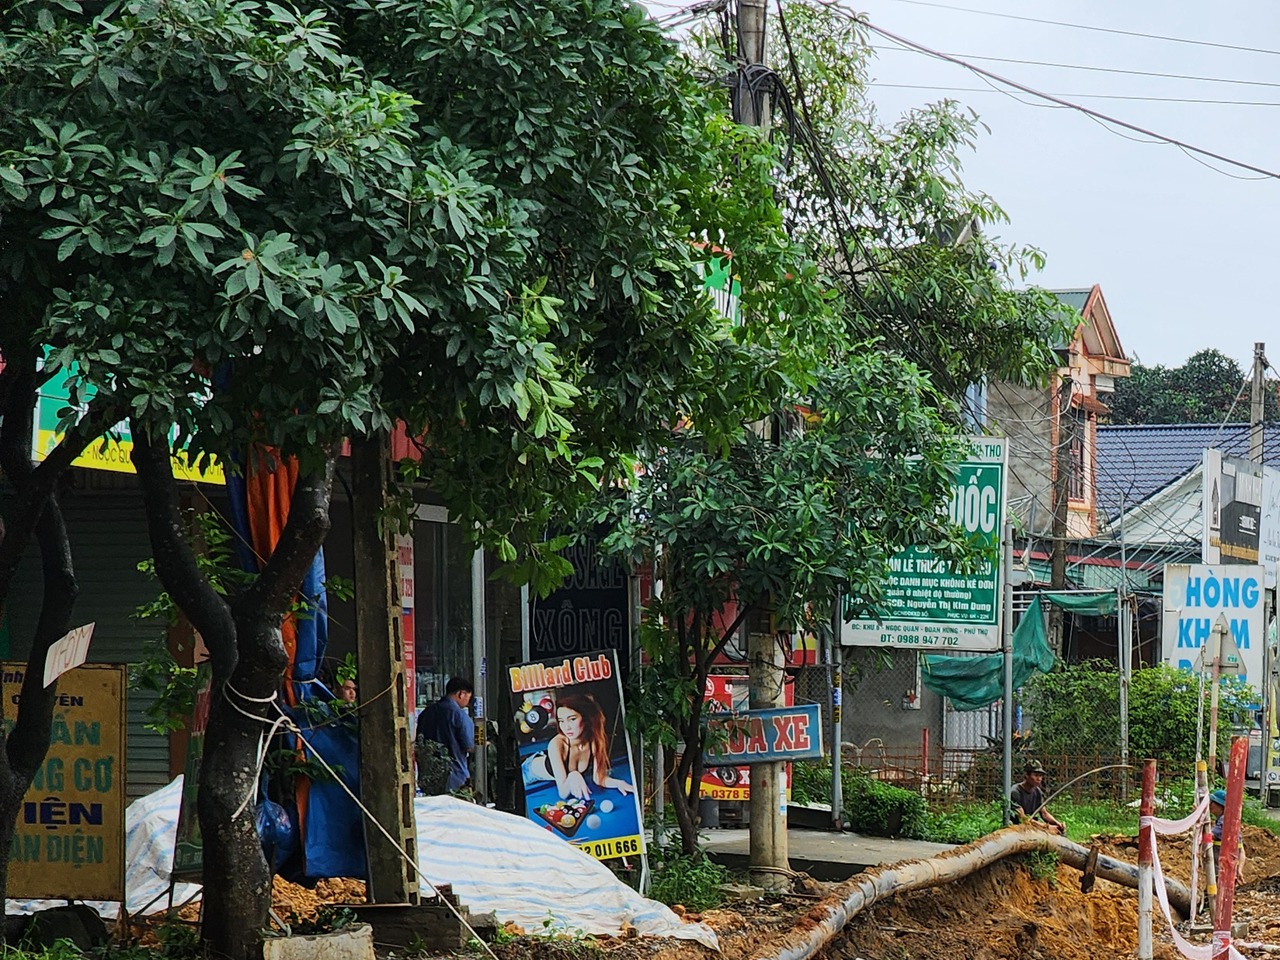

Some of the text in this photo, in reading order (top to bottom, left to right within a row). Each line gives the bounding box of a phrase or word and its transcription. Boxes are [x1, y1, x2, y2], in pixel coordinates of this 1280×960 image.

[985, 444, 1001, 460] THỌ
[951, 468, 996, 533] UỐC
[903, 553, 914, 573] LẺ
[899, 577, 920, 587] DANH
[940, 577, 965, 589] KHÔNG
[907, 598, 937, 610] Nguyễn
[939, 601, 951, 611] Thị
[952, 601, 969, 610] Kim
[970, 602, 992, 612] Dung
[536, 601, 623, 651] XÔNG
[1178, 619, 1250, 649] KHM
[897, 635, 919, 644] 0988
[923, 635, 939, 645] 947
[942, 636, 959, 646] 702
[509, 663, 573, 693] Billiard
[573, 654, 612, 683] Club
[772, 714, 811, 752] XE
[73, 755, 114, 793] CƠ
[711, 789, 739, 799] 0378
[24, 796, 103, 830] IỆN
[595, 843, 612, 858] 011
[615, 839, 638, 855] 666
